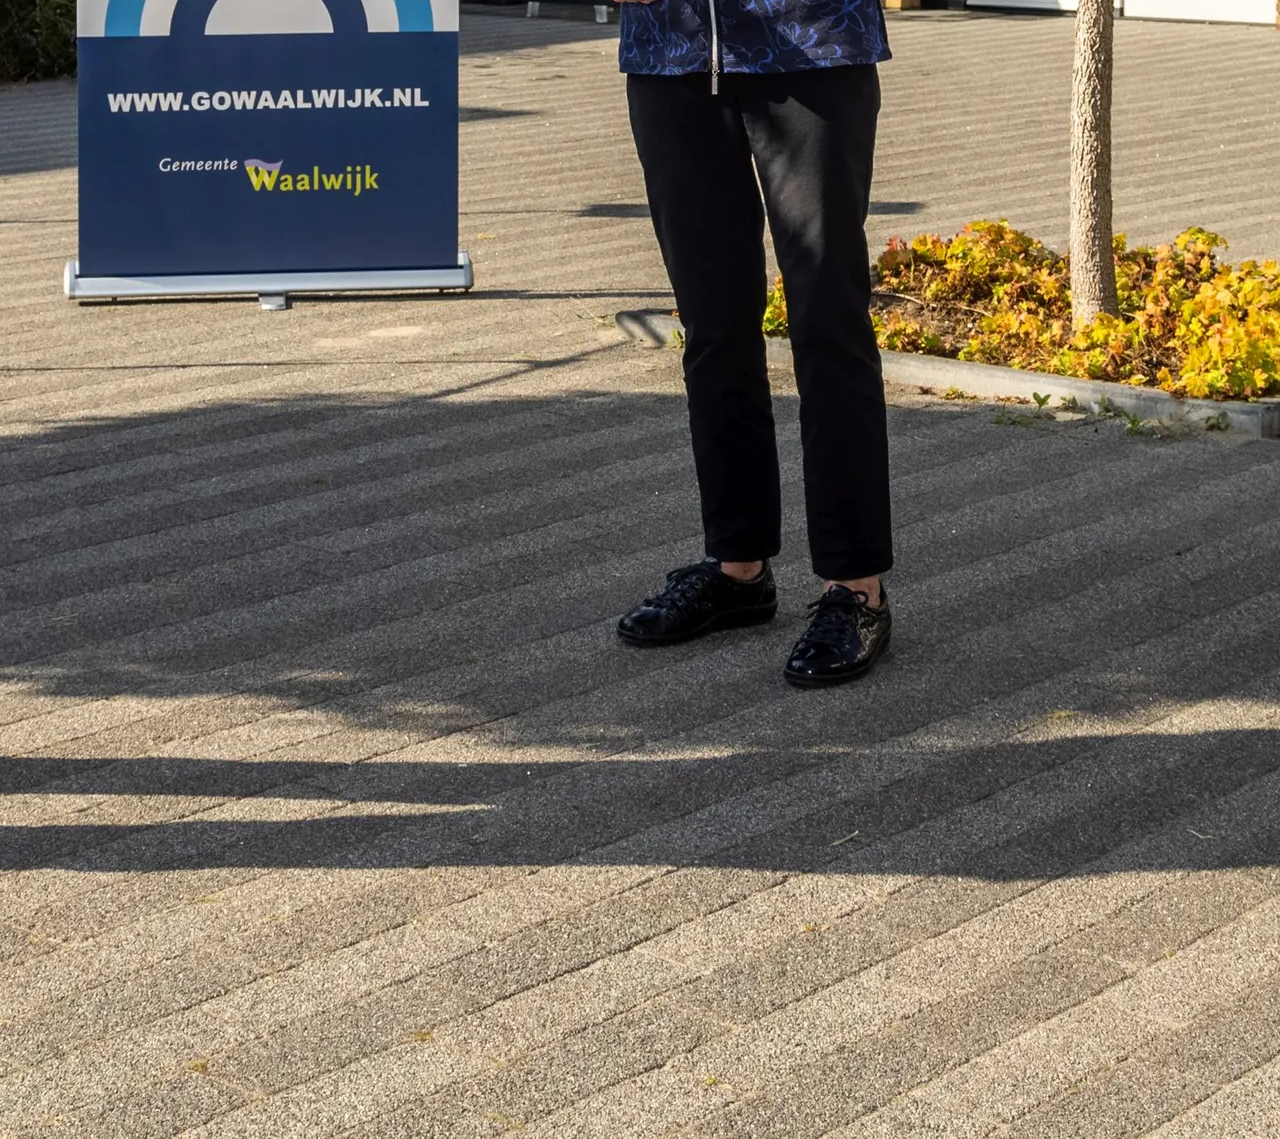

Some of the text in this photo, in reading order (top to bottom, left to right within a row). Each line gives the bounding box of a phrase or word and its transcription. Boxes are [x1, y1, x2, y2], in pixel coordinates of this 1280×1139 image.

[107, 88, 430, 113] WWW.GOWAALWIJK.NL
[159, 158, 379, 196] Gemeente Waalwijk
